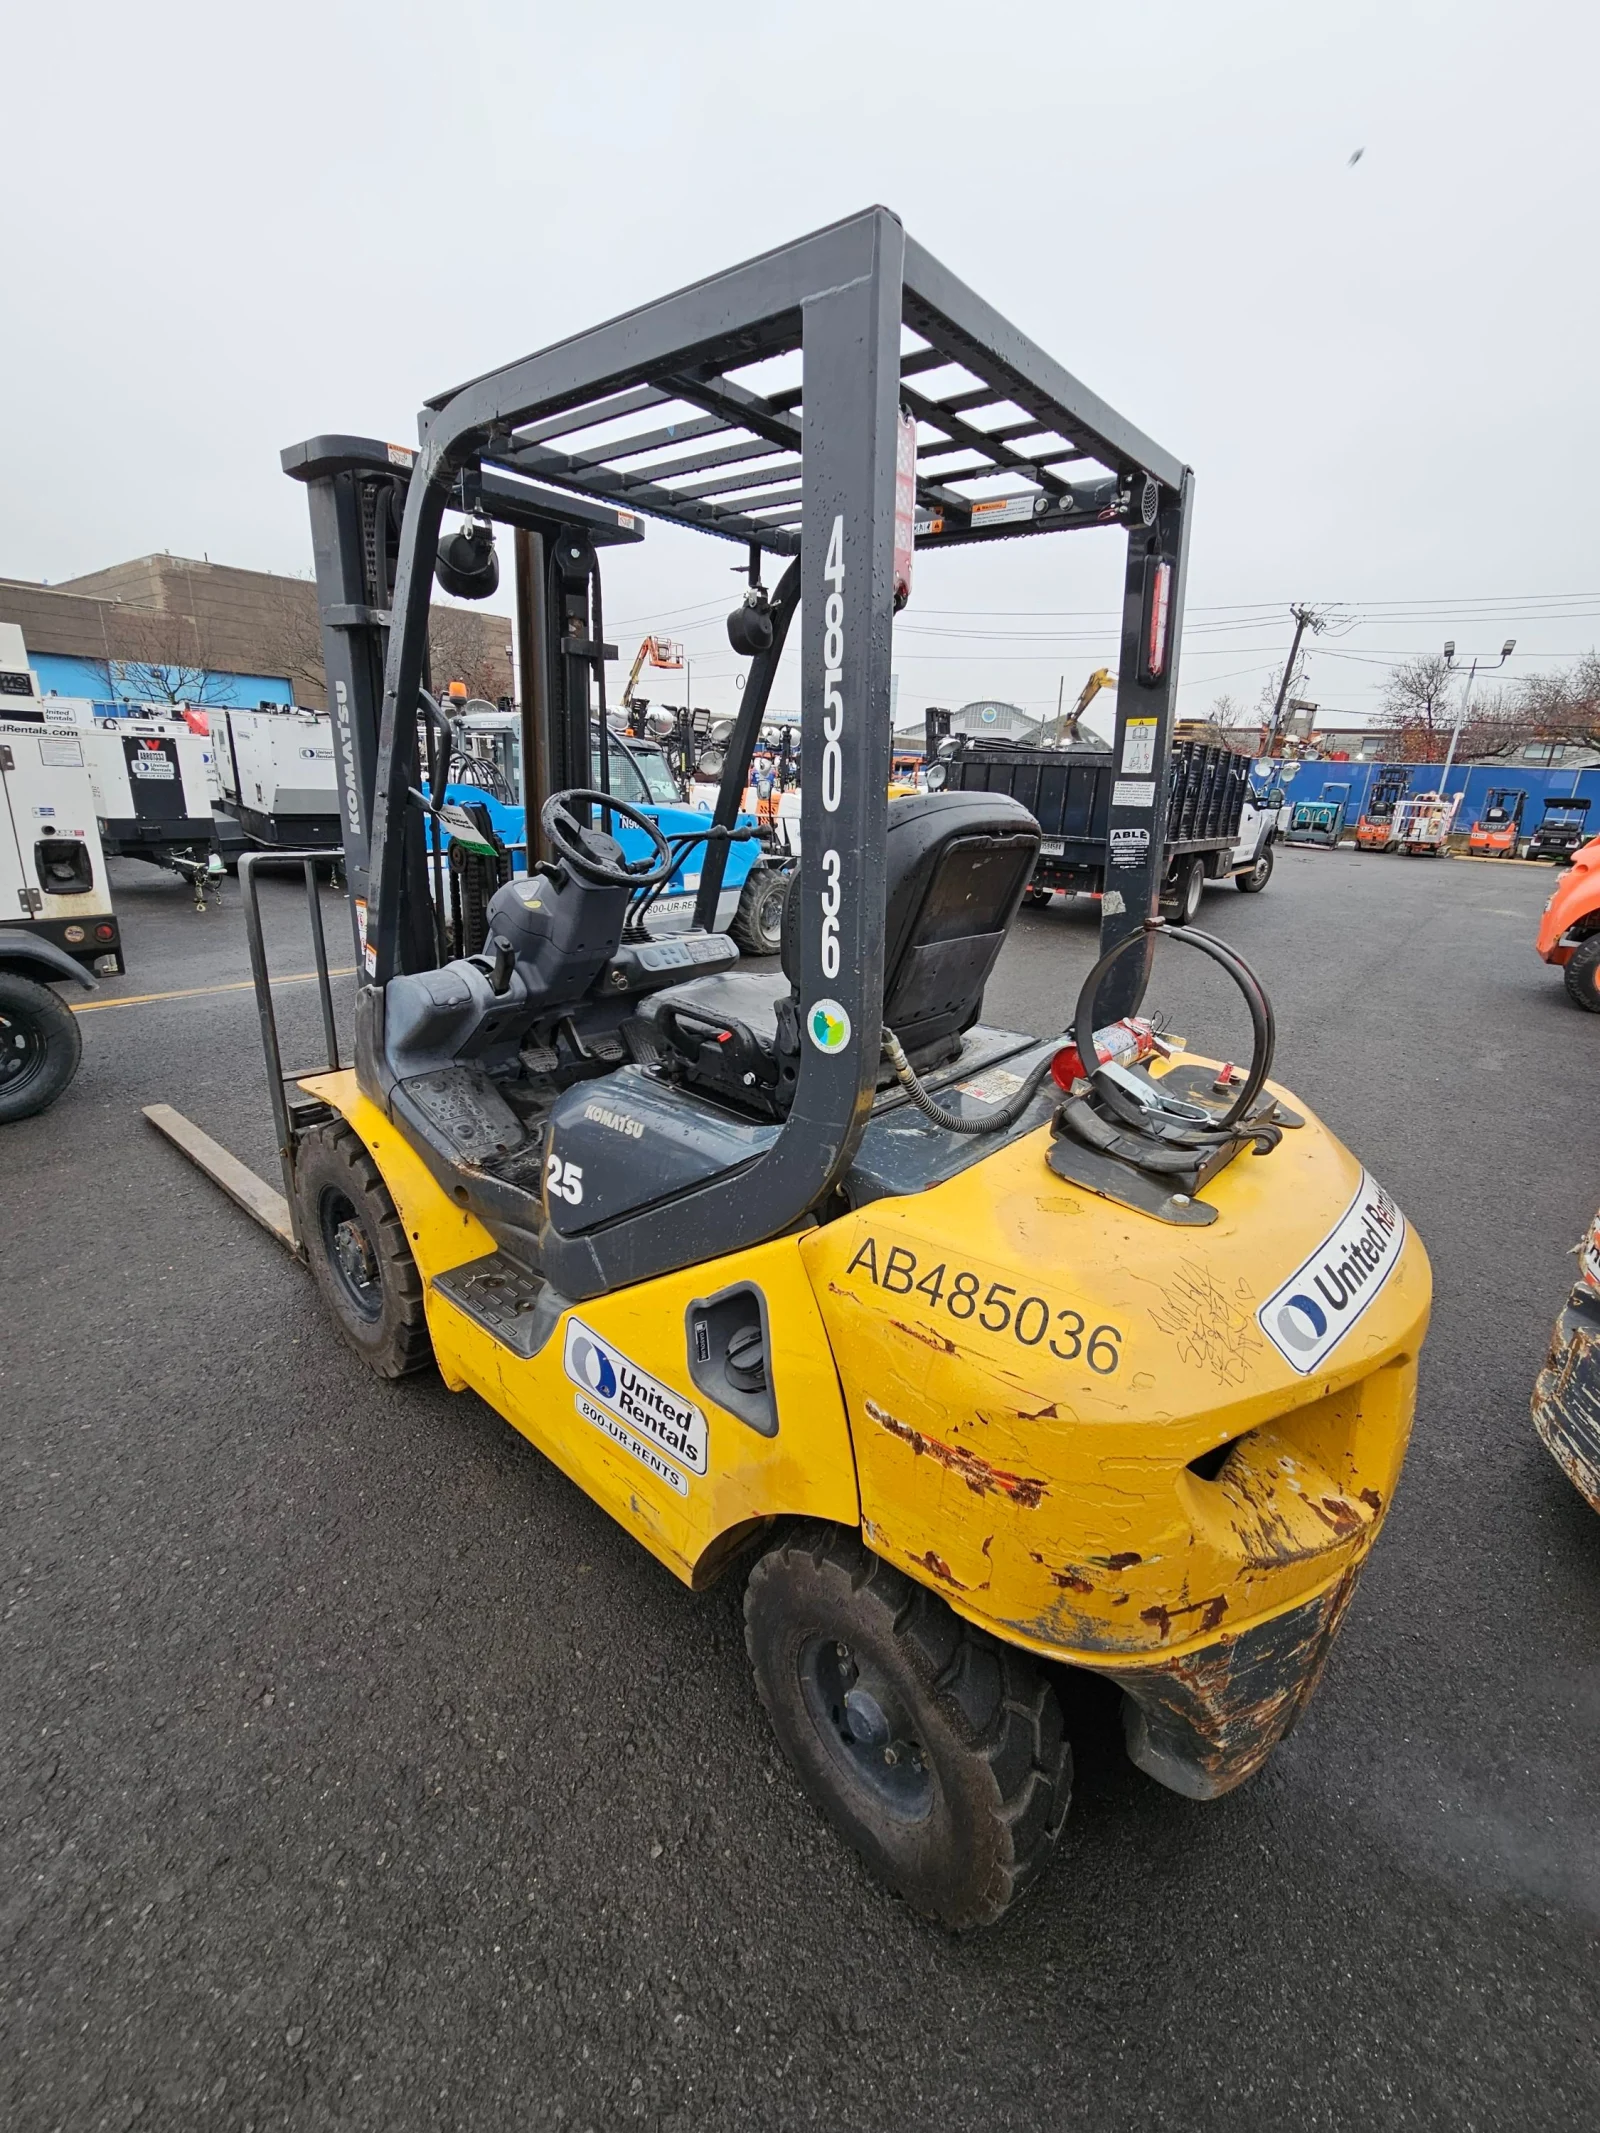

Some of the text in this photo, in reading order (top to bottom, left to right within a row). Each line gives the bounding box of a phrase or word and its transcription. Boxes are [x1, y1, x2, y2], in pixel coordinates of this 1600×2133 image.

[335, 680, 361, 835] KOMATSU
[1113, 831, 1148, 841] ABLE
[584, 1104, 646, 1139] KOMATSU
[546, 1154, 583, 1205] 25
[1313, 1215, 1386, 1311] United
[846, 1237, 1123, 1375] AB485036
[618, 1390, 698, 1462] Rentals
[619, 1366, 693, 1432] United
[582, 1402, 680, 1487] 800-UR-RENTS
